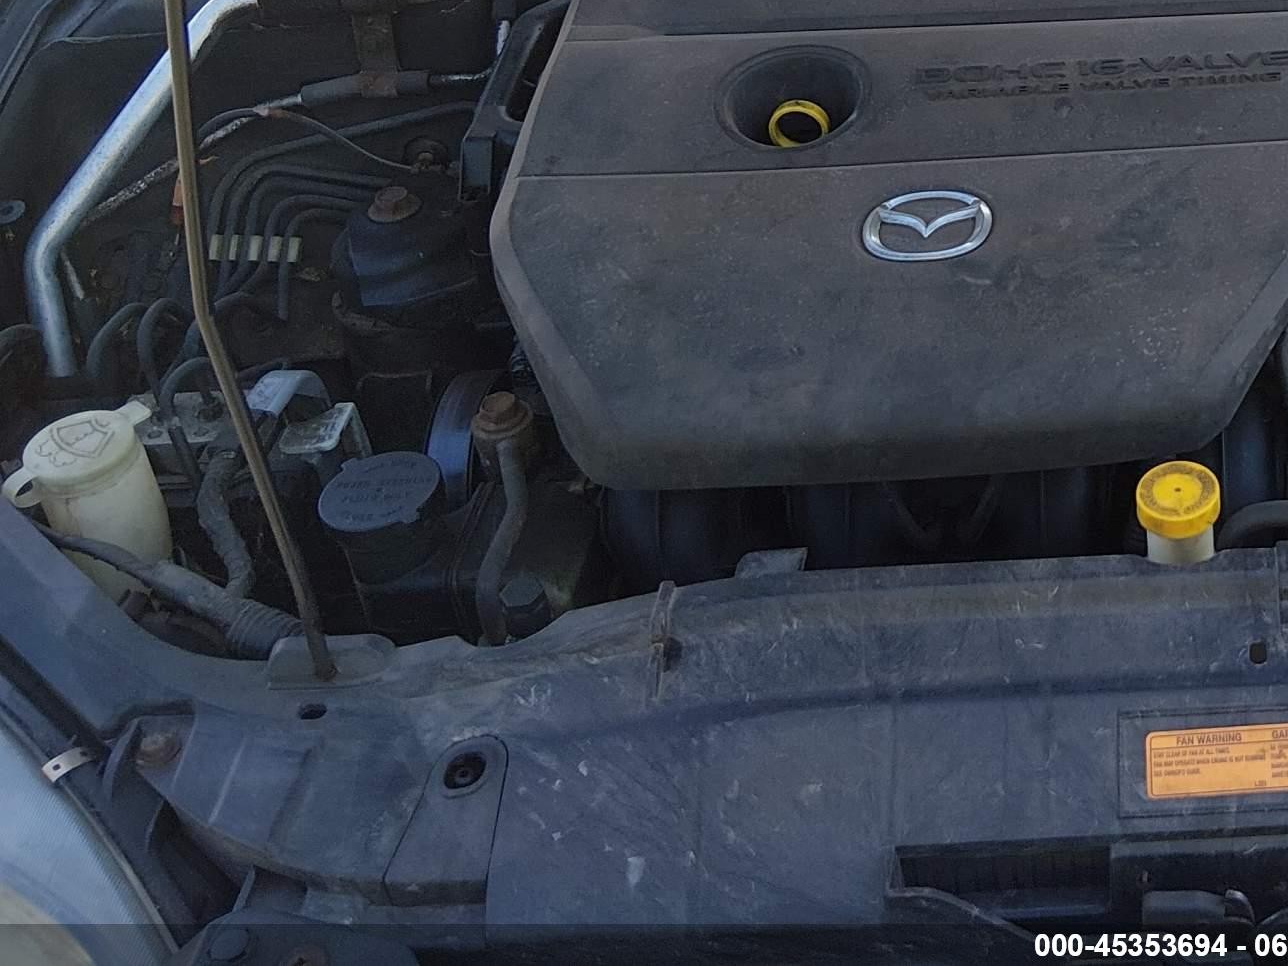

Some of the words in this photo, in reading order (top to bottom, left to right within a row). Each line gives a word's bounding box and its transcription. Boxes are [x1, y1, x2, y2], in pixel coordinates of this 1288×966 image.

[915, 61, 1067, 84] DOHC
[1079, 78, 1170, 92] VALVE
[1180, 71, 1282, 87] TIMING
[1176, 735, 1194, 745] FAN
[1197, 733, 1242, 744] WARNING
